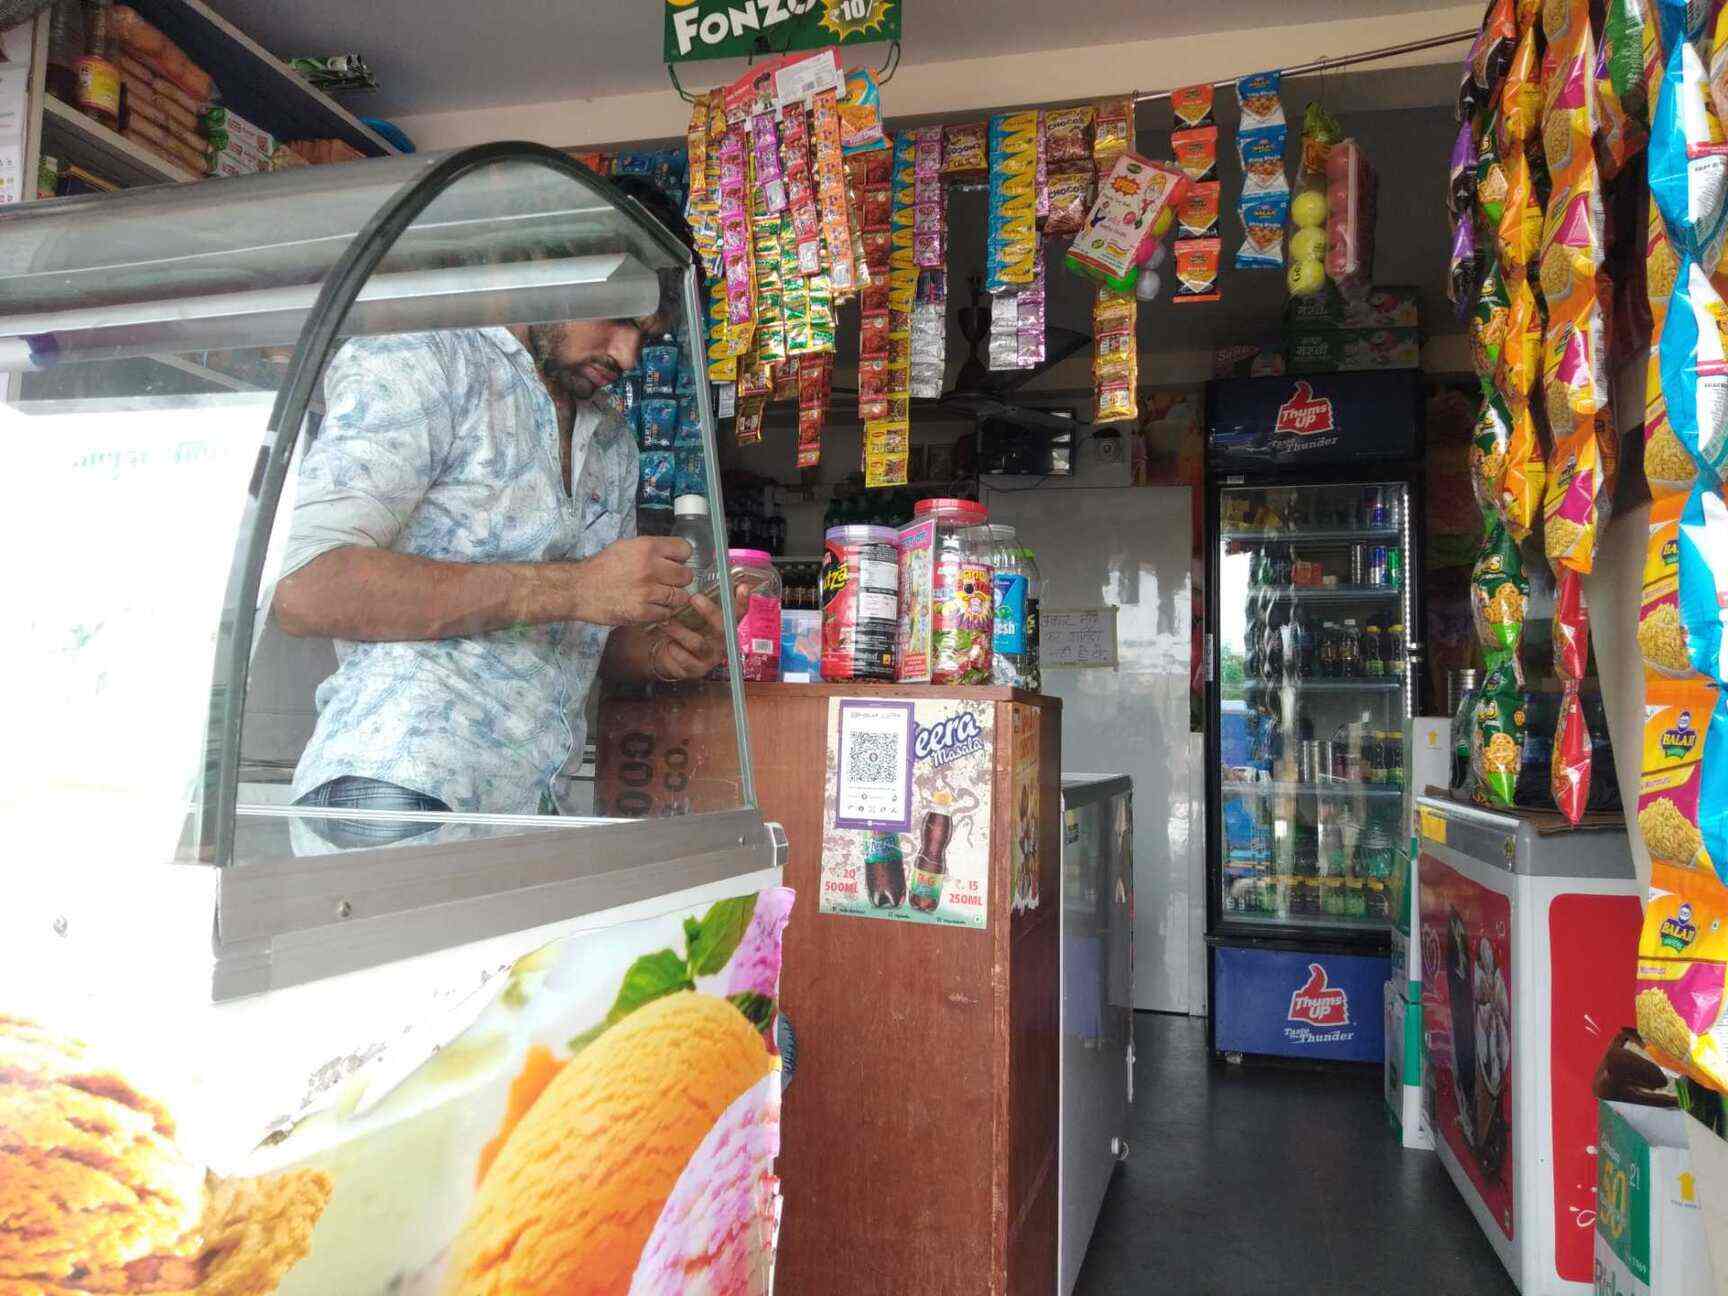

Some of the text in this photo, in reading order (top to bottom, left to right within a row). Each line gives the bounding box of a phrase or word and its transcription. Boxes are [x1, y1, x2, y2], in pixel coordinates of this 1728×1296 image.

[1281, 404, 1328, 422] Thums
[913, 711, 982, 760] eera
[933, 736, 985, 768] Masala
[843, 868, 856, 879] 20
[949, 892, 983, 906] 250ML
[1294, 996, 1342, 1011] Thums
[1298, 1030, 1355, 1043] Thunder
